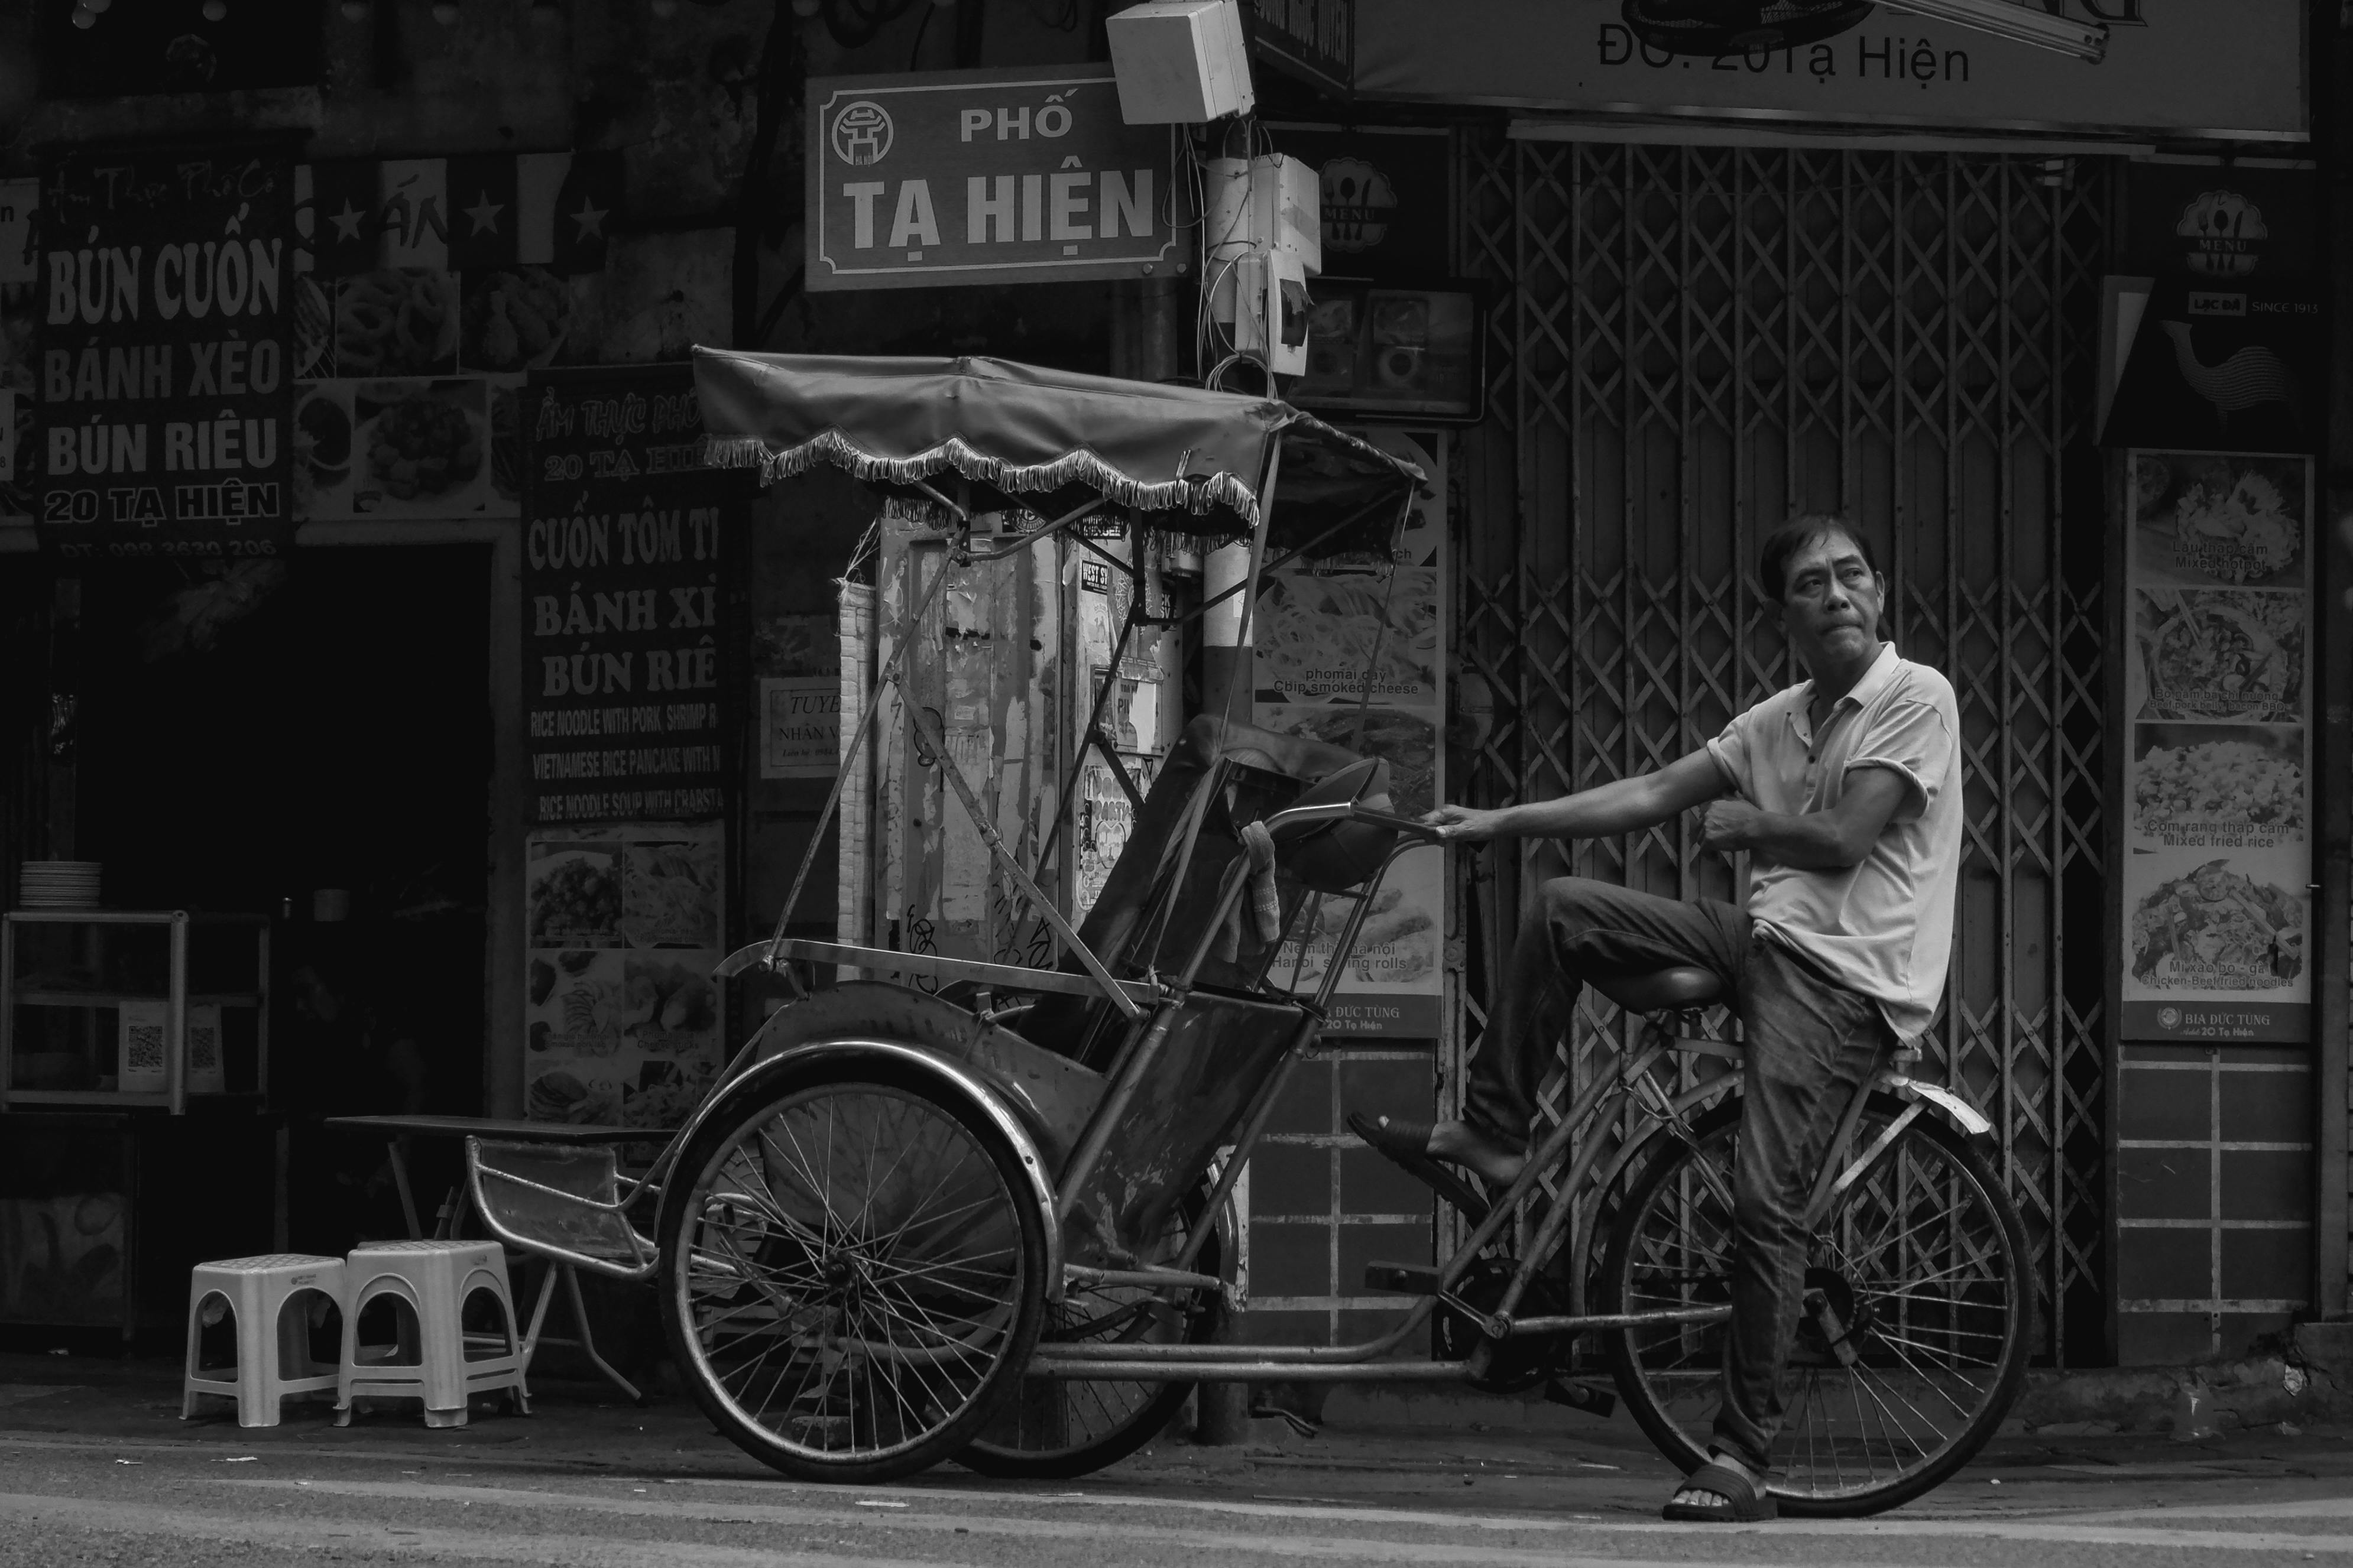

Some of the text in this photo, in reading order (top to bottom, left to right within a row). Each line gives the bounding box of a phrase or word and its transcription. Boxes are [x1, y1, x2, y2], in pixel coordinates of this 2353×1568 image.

[1859, 36, 1969, 89] Hiện
[961, 89, 1078, 142] PHỐ
[843, 155, 1153, 262] TẠ HIỆN
[1323, 207, 1375, 220] MENU
[2199, 239, 2247, 252] MENU
[47, 225, 142, 324] BÚN
[154, 202, 282, 320] CUỐN
[2251, 301, 2290, 313] SINCE
[2294, 302, 2318, 314] 1913
[45, 329, 281, 402] BÁNH XÈO
[47, 414, 147, 475] BÚN
[165, 408, 277, 471] RIÊU
[544, 454, 584, 482] 20
[589, 449, 641, 482] TẠ
[44, 477, 280, 528] 20 TẠ HIỆN
[529, 490, 610, 571] CUỐN
[618, 494, 682, 566] TÔM
[2175, 556, 2216, 569] Mixed
[534, 581, 658, 636] BÁNH
[542, 641, 633, 696] BÚN
[1311, 681, 1365, 694] smoked
[1369, 682, 1419, 694] cheese
[531, 711, 555, 738] RICE
[557, 708, 601, 737] NOODLE
[602, 707, 630, 735] WITH
[666, 703, 706, 732] SHRIMP
[532, 751, 600, 780] VIETNAMESE
[602, 749, 627, 777] RICE
[629, 747, 681, 775] PANCAKE
[682, 745, 711, 773] WITH
[539, 795, 563, 822] RICE
[565, 792, 609, 820] NOODLE
[644, 789, 672, 815] WITH
[2163, 834, 2274, 848] Mixed fried rice
[1375, 956, 1406, 969] rolls
[1336, 1004, 1362, 1018] ĐỨC
[1365, 1004, 1400, 1018] TÙNG
[2185, 1014, 2206, 1025] BIA
[2201, 1026, 2216, 1036] 20
